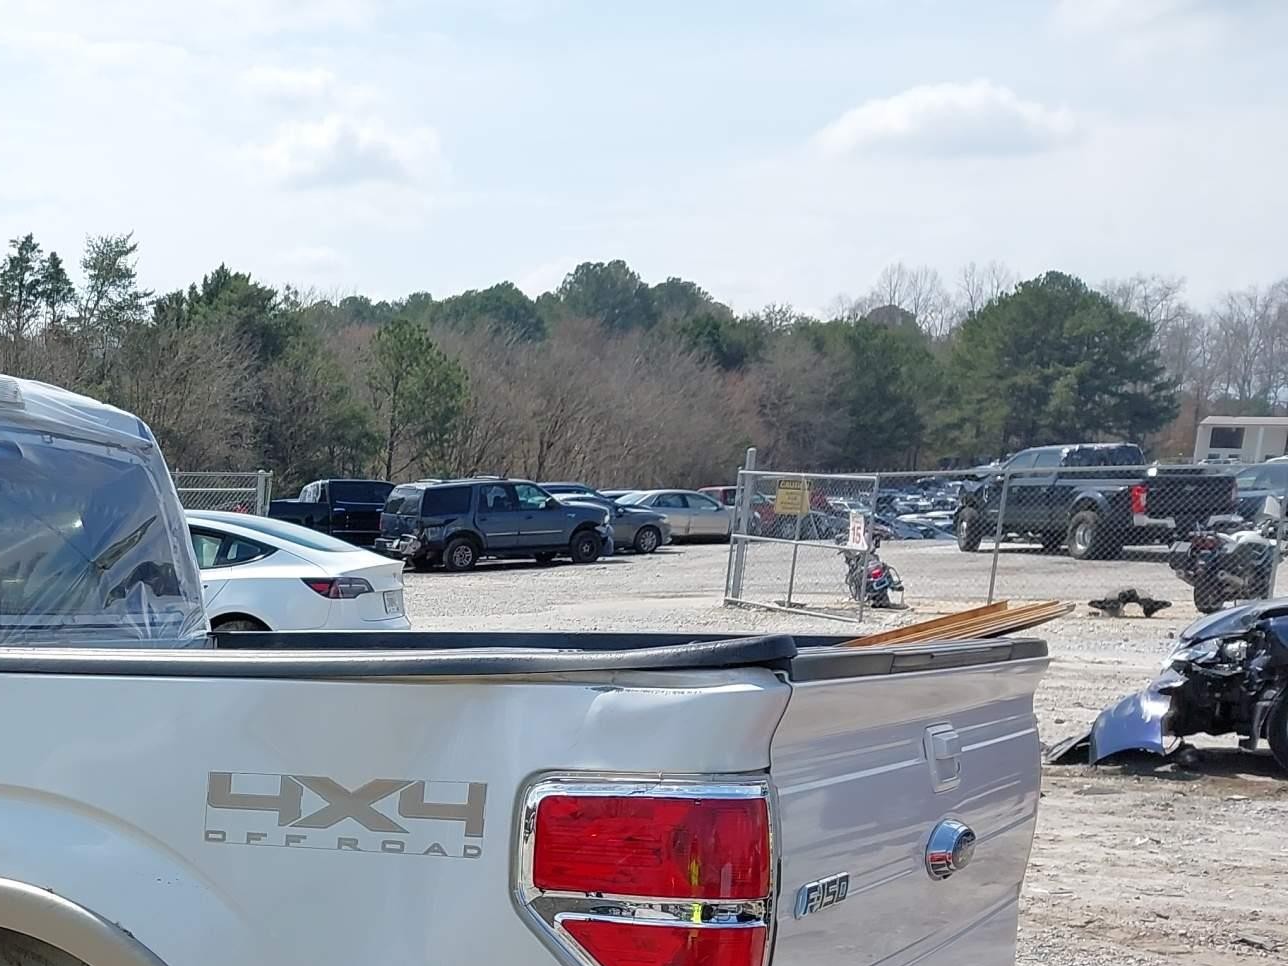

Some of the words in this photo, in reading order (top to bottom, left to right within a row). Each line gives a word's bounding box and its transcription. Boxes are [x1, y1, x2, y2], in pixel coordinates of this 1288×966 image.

[204, 830, 308, 849] OFF
[337, 837, 483, 859] ROAD
[799, 873, 850, 915] F-150
